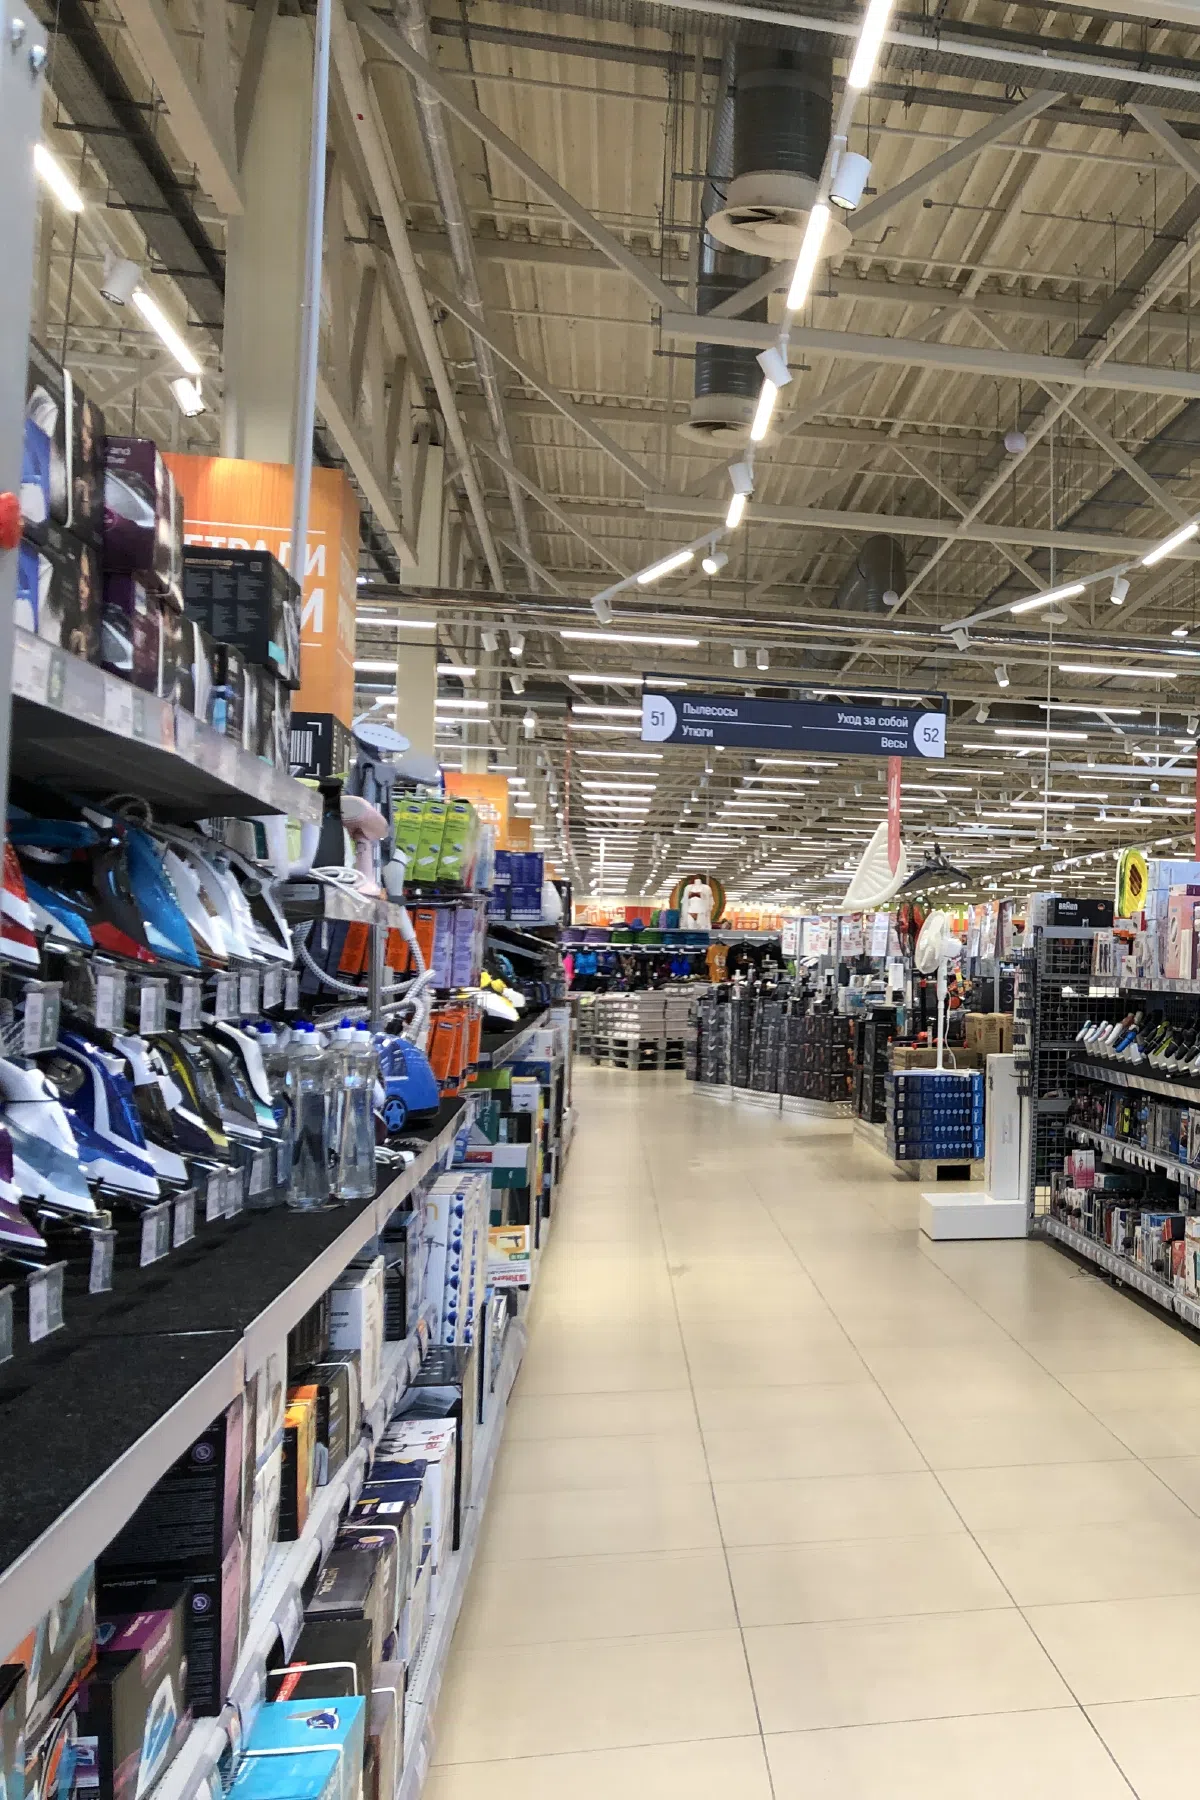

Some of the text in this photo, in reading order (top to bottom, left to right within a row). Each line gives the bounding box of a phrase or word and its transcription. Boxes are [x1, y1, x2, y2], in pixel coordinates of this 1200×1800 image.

[683, 703, 738, 718] Пылесосы
[650, 711, 666, 727] 51
[837, 712, 909, 728] Уход за собой
[682, 724, 714, 739] Утюги
[923, 728, 940, 743] 52
[881, 736, 908, 750] Весы
[1058, 901, 1078, 910] BRAUN
